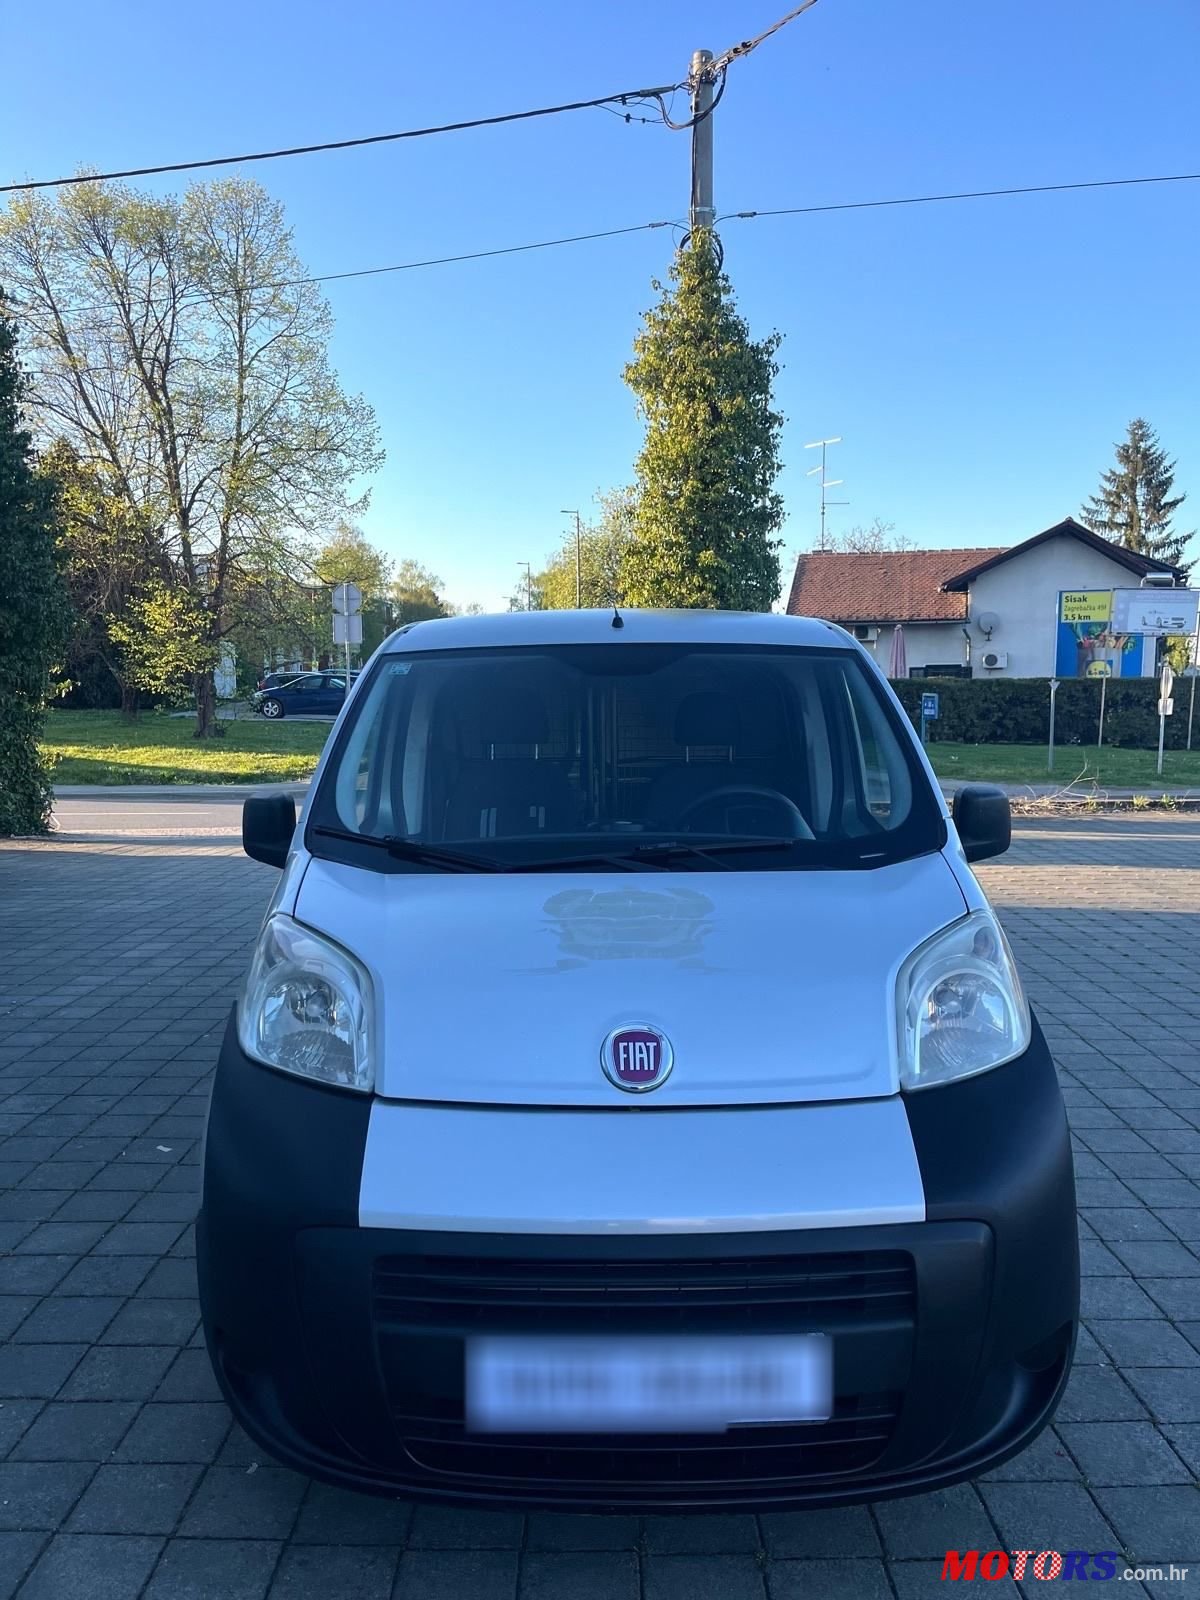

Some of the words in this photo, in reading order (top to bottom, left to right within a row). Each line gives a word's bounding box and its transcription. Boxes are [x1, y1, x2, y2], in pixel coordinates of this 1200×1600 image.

[1064, 595, 1088, 603] Sisak
[1064, 613, 1076, 621] 3.5
[1078, 613, 1091, 621] km
[618, 1042, 657, 1071] FIAT
